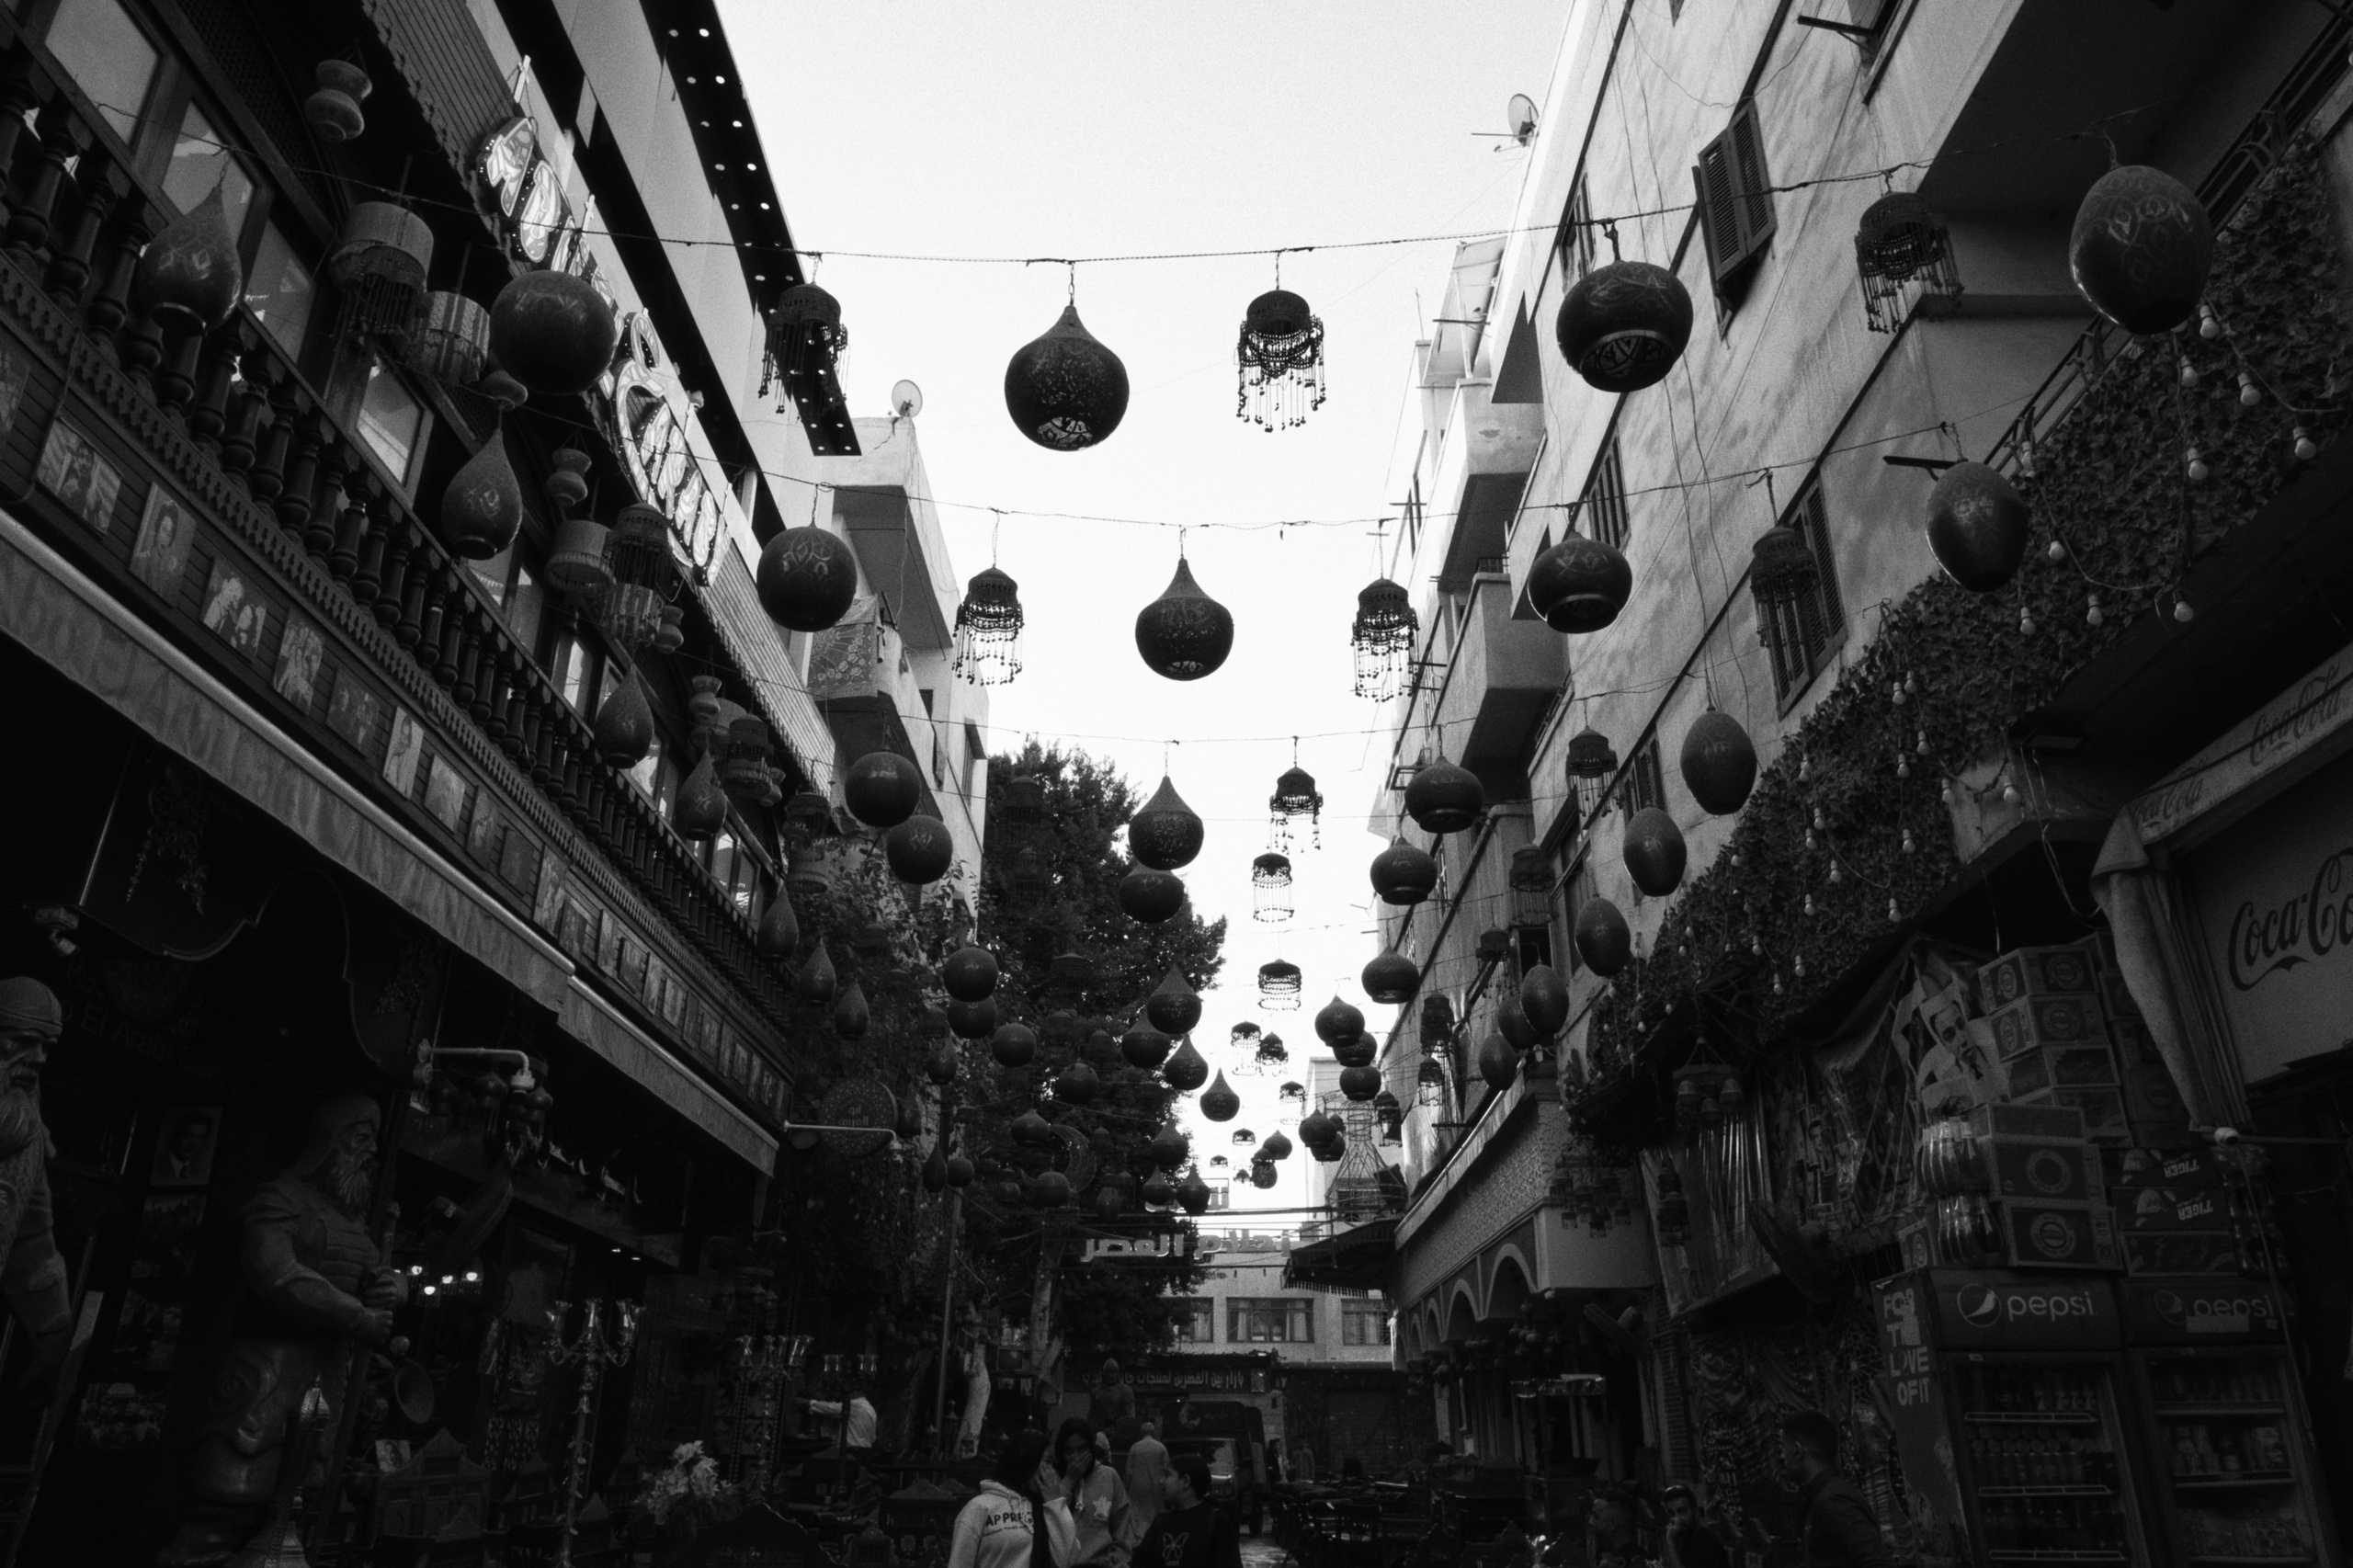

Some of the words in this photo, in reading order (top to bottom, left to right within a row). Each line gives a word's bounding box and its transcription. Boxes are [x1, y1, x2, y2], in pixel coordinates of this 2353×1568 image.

[2249, 661, 2341, 767] Coca-Cola
[2227, 846, 2353, 991] Coca-Co
[2163, 1158, 2200, 1179] TIGER
[2177, 1199, 2215, 1221] TIGER
[1080, 1233, 1185, 1264] العصر
[2006, 1291, 2094, 1322] pepsi
